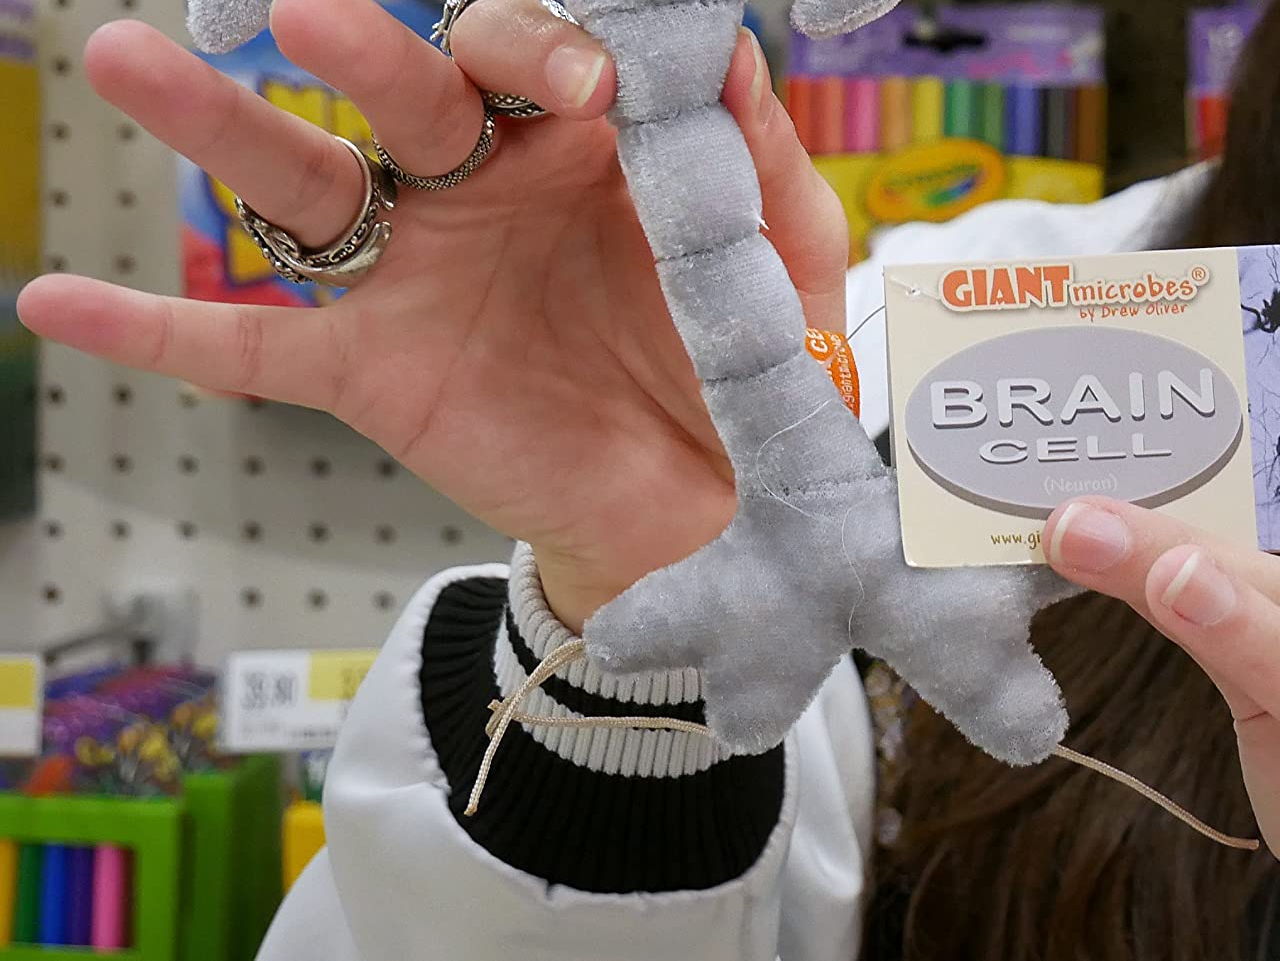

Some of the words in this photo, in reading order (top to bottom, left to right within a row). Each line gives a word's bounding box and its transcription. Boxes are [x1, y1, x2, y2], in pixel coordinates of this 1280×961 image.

[1079, 307, 1095, 322] by
[1101, 304, 1139, 319] Drew
[1145, 302, 1188, 316] Oliver
[930, 367, 1217, 430] BRAIN
[978, 433, 1173, 465] CELL
[1042, 474, 1119, 495] (Neuron)
